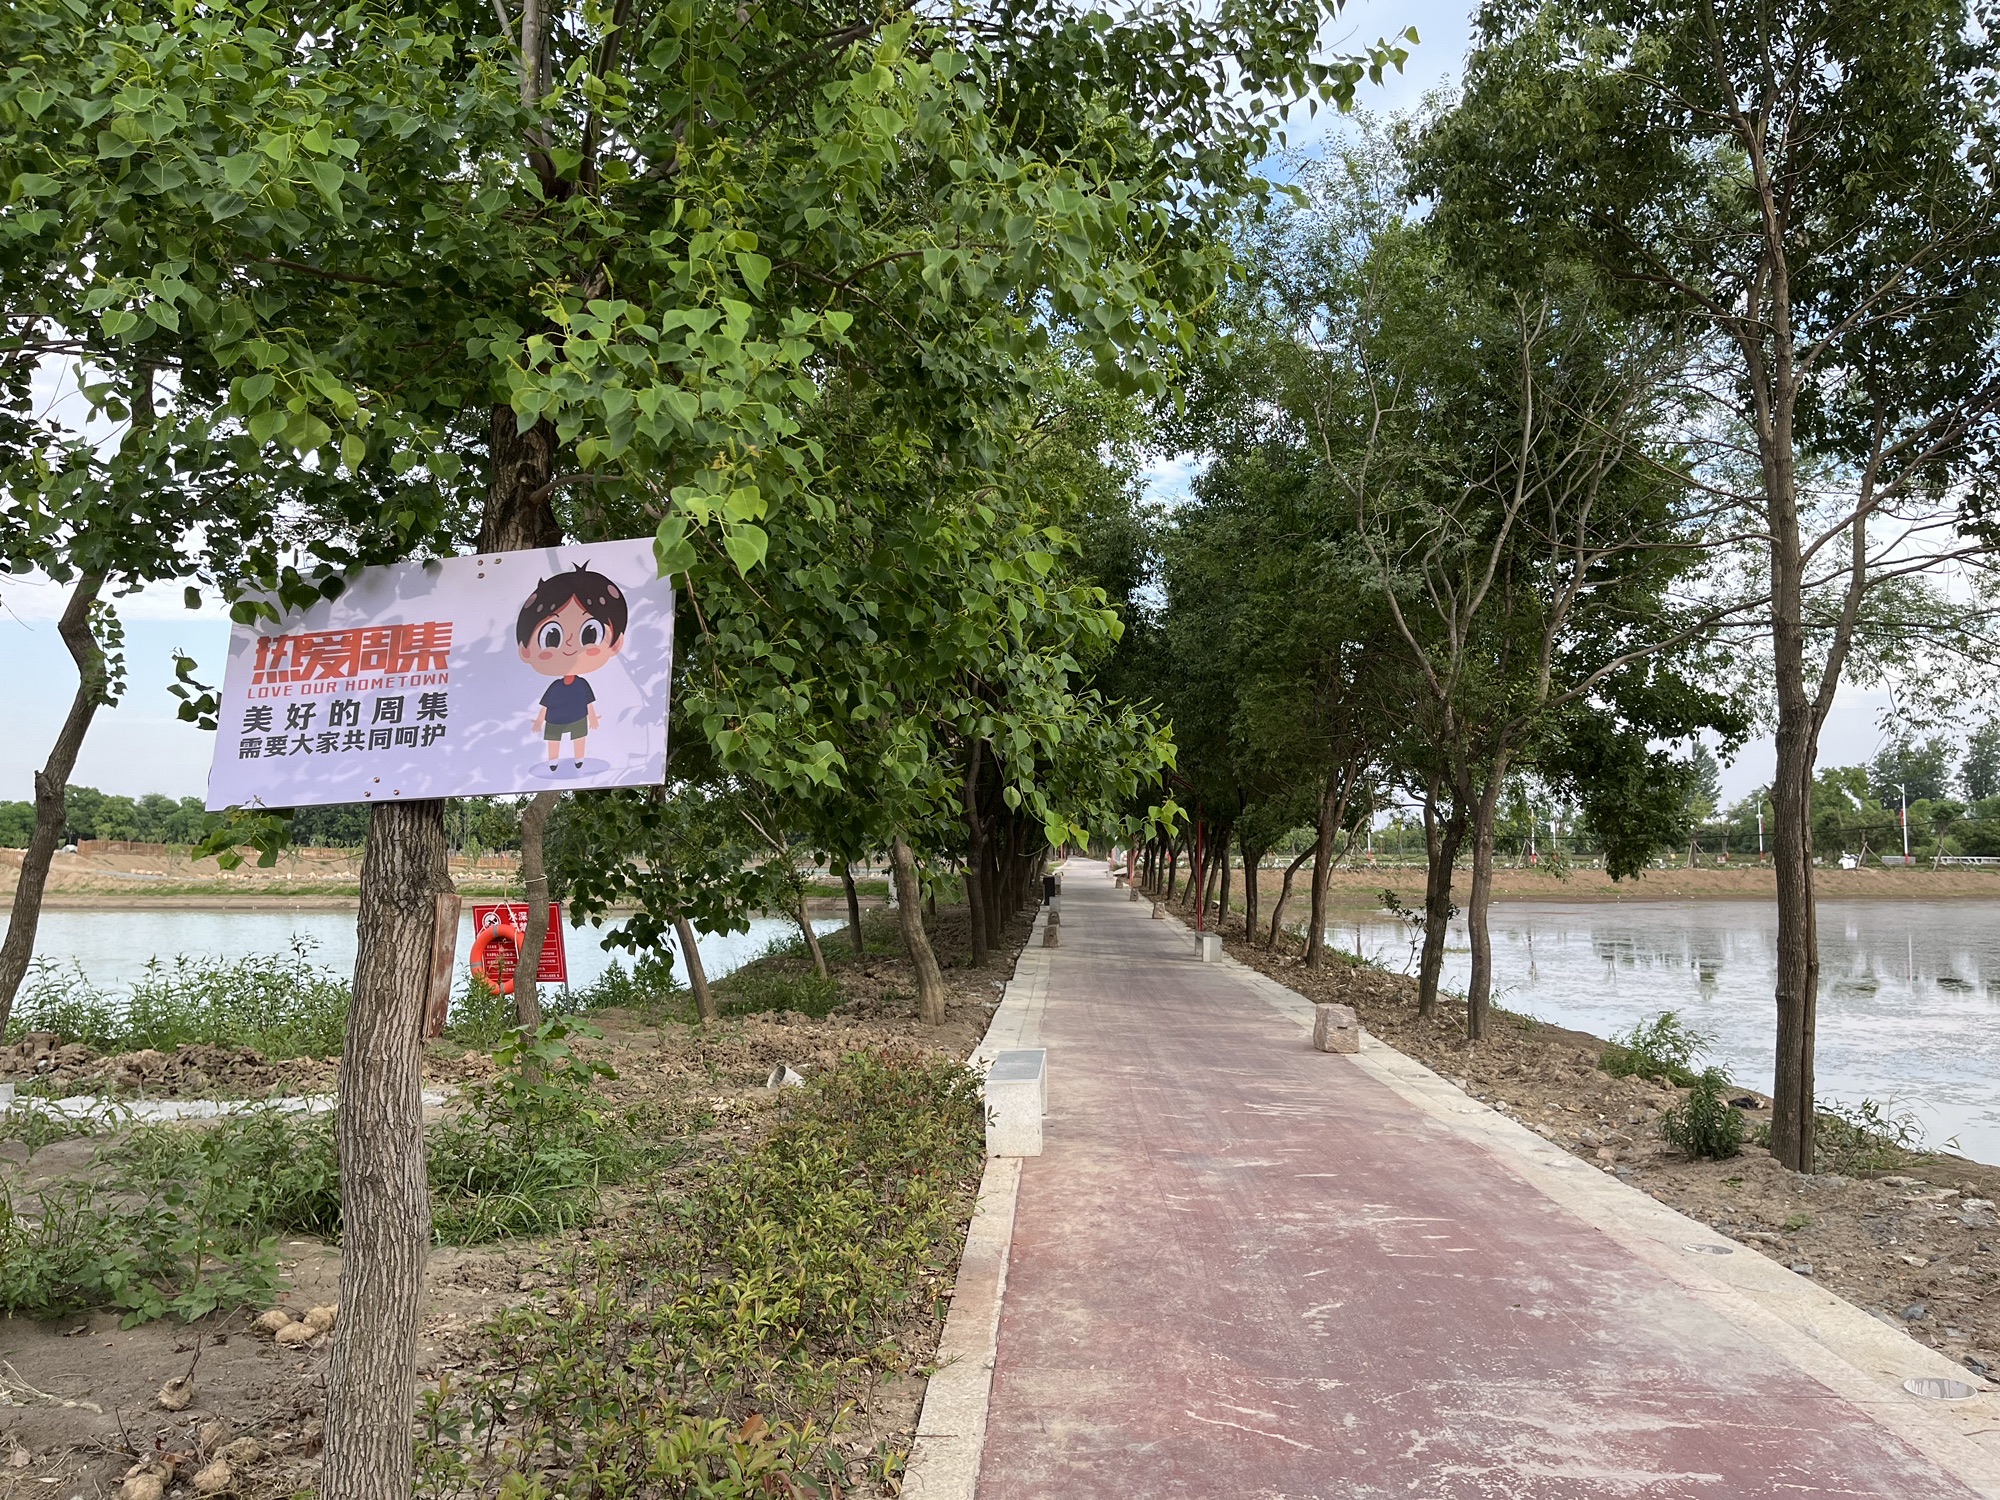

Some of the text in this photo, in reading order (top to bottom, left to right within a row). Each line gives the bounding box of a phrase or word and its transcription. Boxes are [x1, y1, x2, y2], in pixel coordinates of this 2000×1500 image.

[251, 621, 453, 685] 热爱周集
[247, 672, 449, 699] LOVE OUR HOMETOWN
[241, 692, 449, 735] 美好的周集
[239, 723, 447, 760] 需要大家共同呵护
